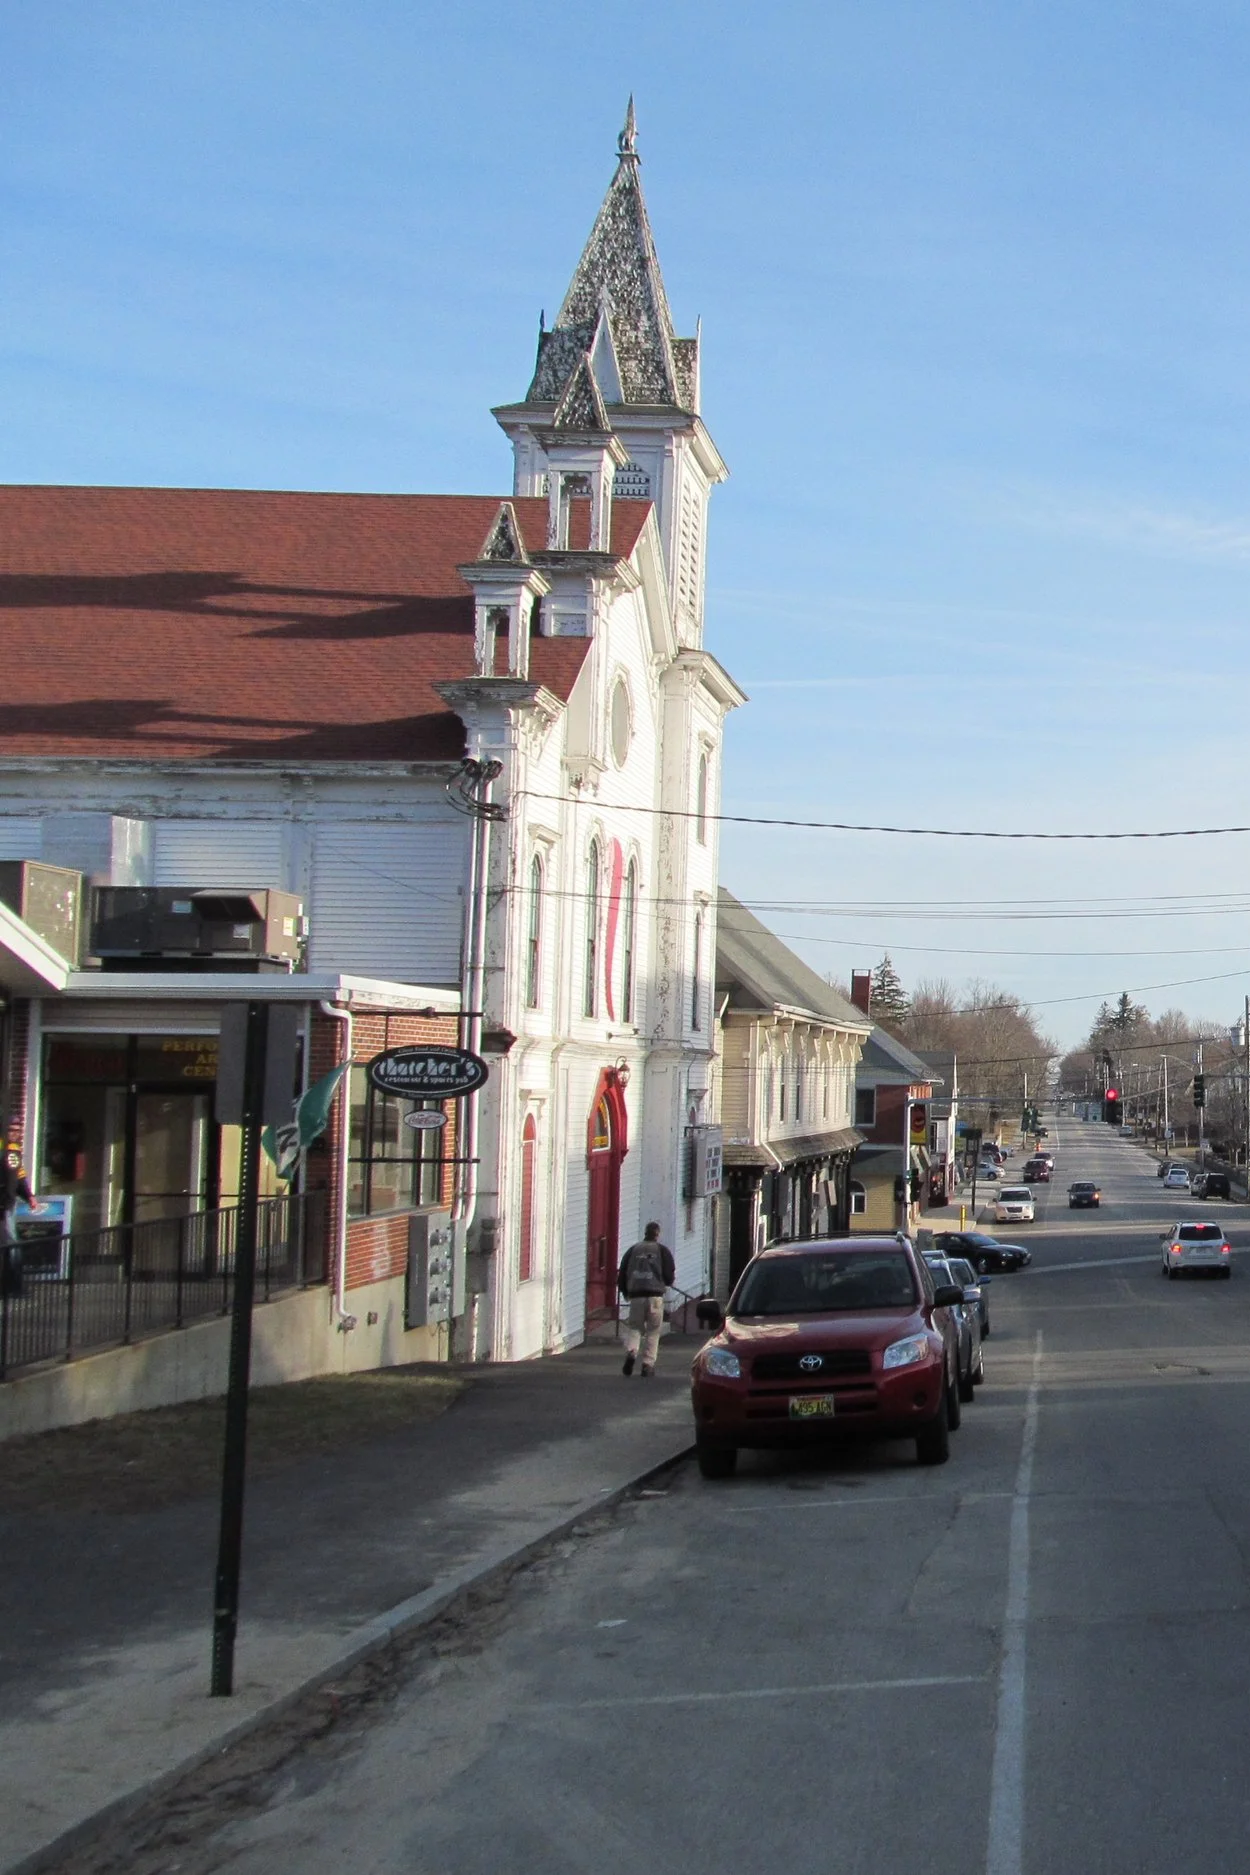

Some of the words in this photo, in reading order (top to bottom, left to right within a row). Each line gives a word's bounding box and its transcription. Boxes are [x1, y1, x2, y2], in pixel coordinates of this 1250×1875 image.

[162, 1040, 218, 1052] PERFO
[196, 1054, 218, 1064] AR
[183, 1065, 217, 1077] CEN
